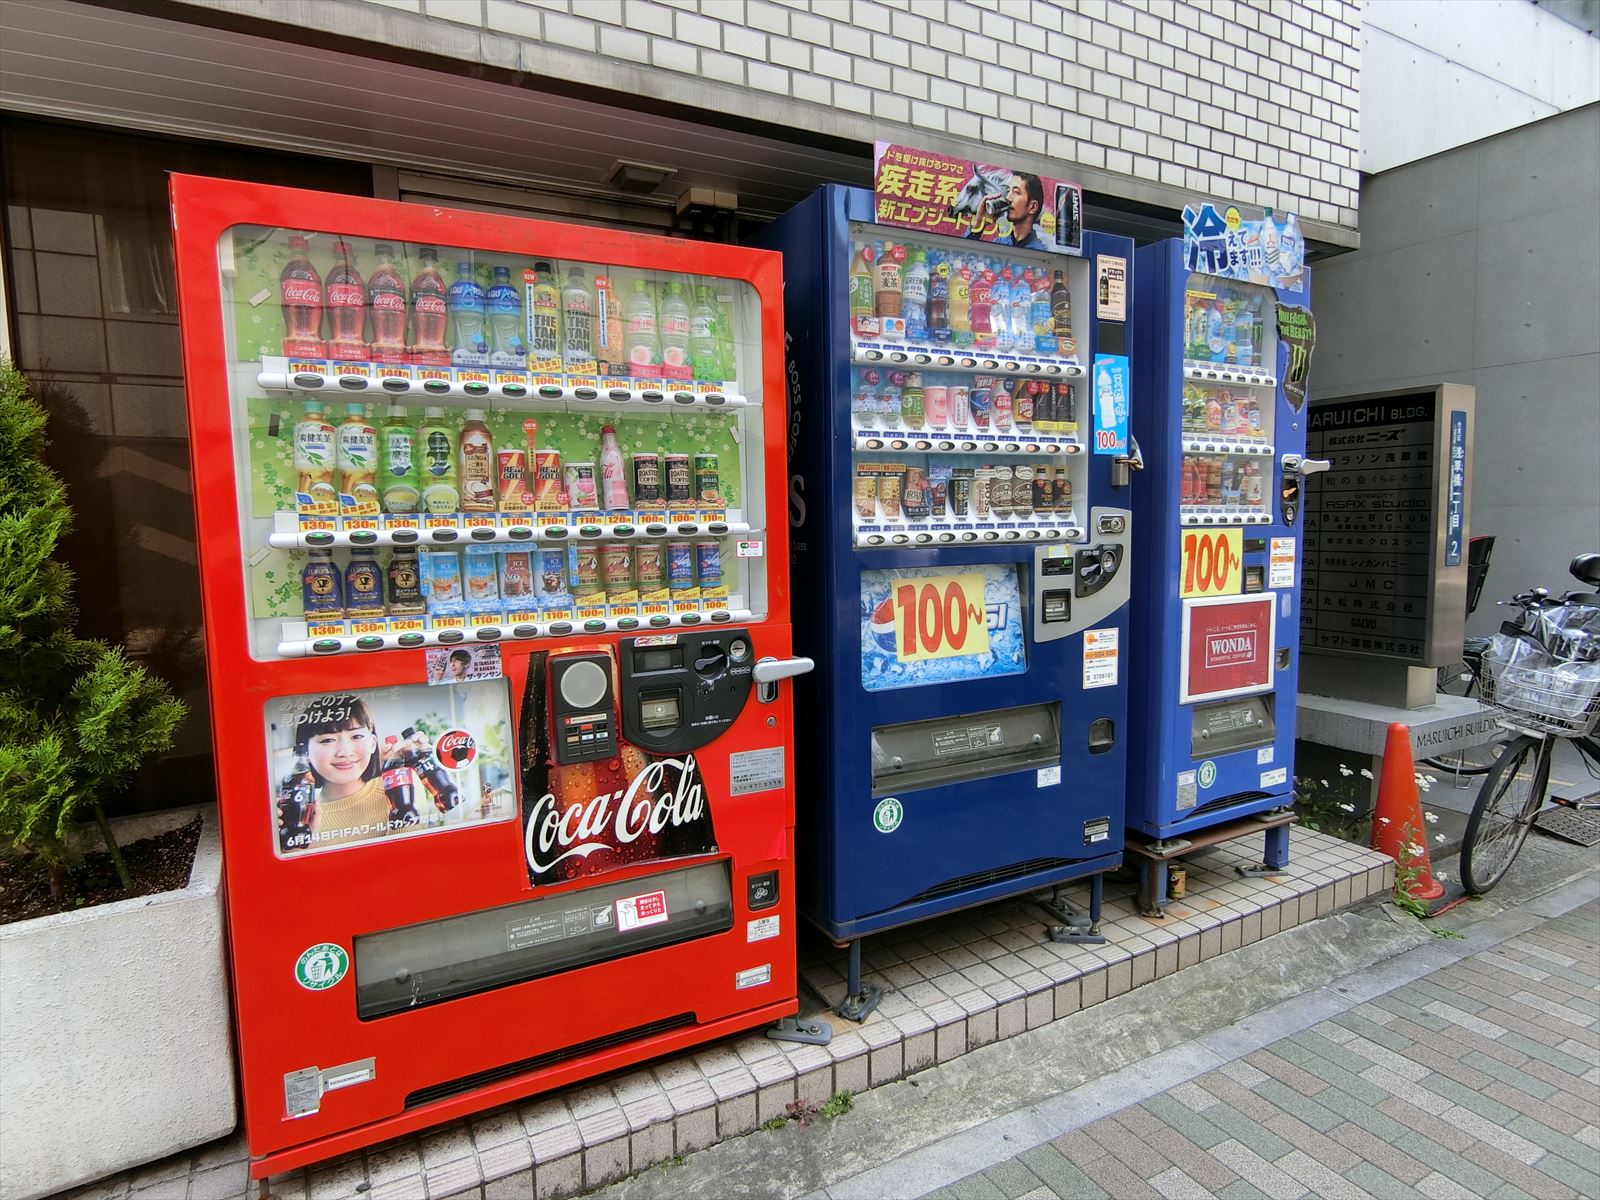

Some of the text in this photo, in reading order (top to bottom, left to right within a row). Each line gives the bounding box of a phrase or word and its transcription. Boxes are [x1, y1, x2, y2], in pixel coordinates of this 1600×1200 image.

[877, 163, 968, 208] 疾走系
[878, 199, 1014, 238] 新エナジードリンク
[1181, 203, 1230, 274] 冷
[1228, 230, 1248, 247] えて
[1229, 247, 1262, 270] ます!!!
[881, 278, 898, 289] 麦茶
[286, 287, 320, 303] Coca-Cola
[330, 290, 364, 306] Coca-Cola
[451, 284, 484, 300] AQUARIU
[374, 293, 405, 310] Coca-Cola
[416, 296, 447, 311] Coca-Cola
[535, 315, 557, 327] THE
[568, 317, 590, 329] THE
[535, 327, 557, 339] TAN
[568, 328, 590, 341] TAN
[534, 340, 557, 351] SAN
[568, 340, 590, 352] SAN
[788, 359, 801, 405] BOSS
[1306, 406, 1428, 429] ARUICHI BLDG.
[300, 433, 332, 445] 爽健美茶
[343, 434, 374, 446] 爽健美茶
[1096, 431, 1116, 449] 100
[503, 472, 525, 480] GOLD
[539, 472, 560, 480] GOLD
[1326, 499, 1366, 509] ASAX
[344, 520, 375, 529] 130円
[387, 520, 417, 528] 130円
[428, 519, 456, 527] 130円
[465, 518, 493, 527] 130円
[505, 517, 530, 526] 110円
[541, 517, 564, 525] 110円
[579, 516, 602, 525] 110円
[608, 516, 632, 524] 120円
[639, 515, 662, 524] 100円
[673, 515, 695, 523] 100円
[303, 521, 333, 530] 130円
[1451, 540, 1458, 557] 2
[643, 606, 666, 614] 100円
[1322, 597, 1413, 613] 丸松株式会社
[512, 613, 535, 621] 110円
[546, 611, 569, 620] 110円
[579, 609, 603, 617] 100円
[392, 620, 424, 631] 120円
[436, 618, 461, 627] 110円
[474, 616, 499, 624] 110円
[312, 625, 342, 636] 130円
[353, 623, 384, 633] 130円
[1210, 636, 1252, 656] WONDA
[466, 671, 501, 681] ザ・タンサン
[281, 707, 352, 727] 見つけよう!
[1417, 717, 1499, 748] MARUICHI BUILDIN
[294, 790, 303, 802] 6
[525, 754, 705, 874] Coca-Cola
[300, 944, 343, 965] のんだあとは
[303, 971, 343, 988] リサイクル
